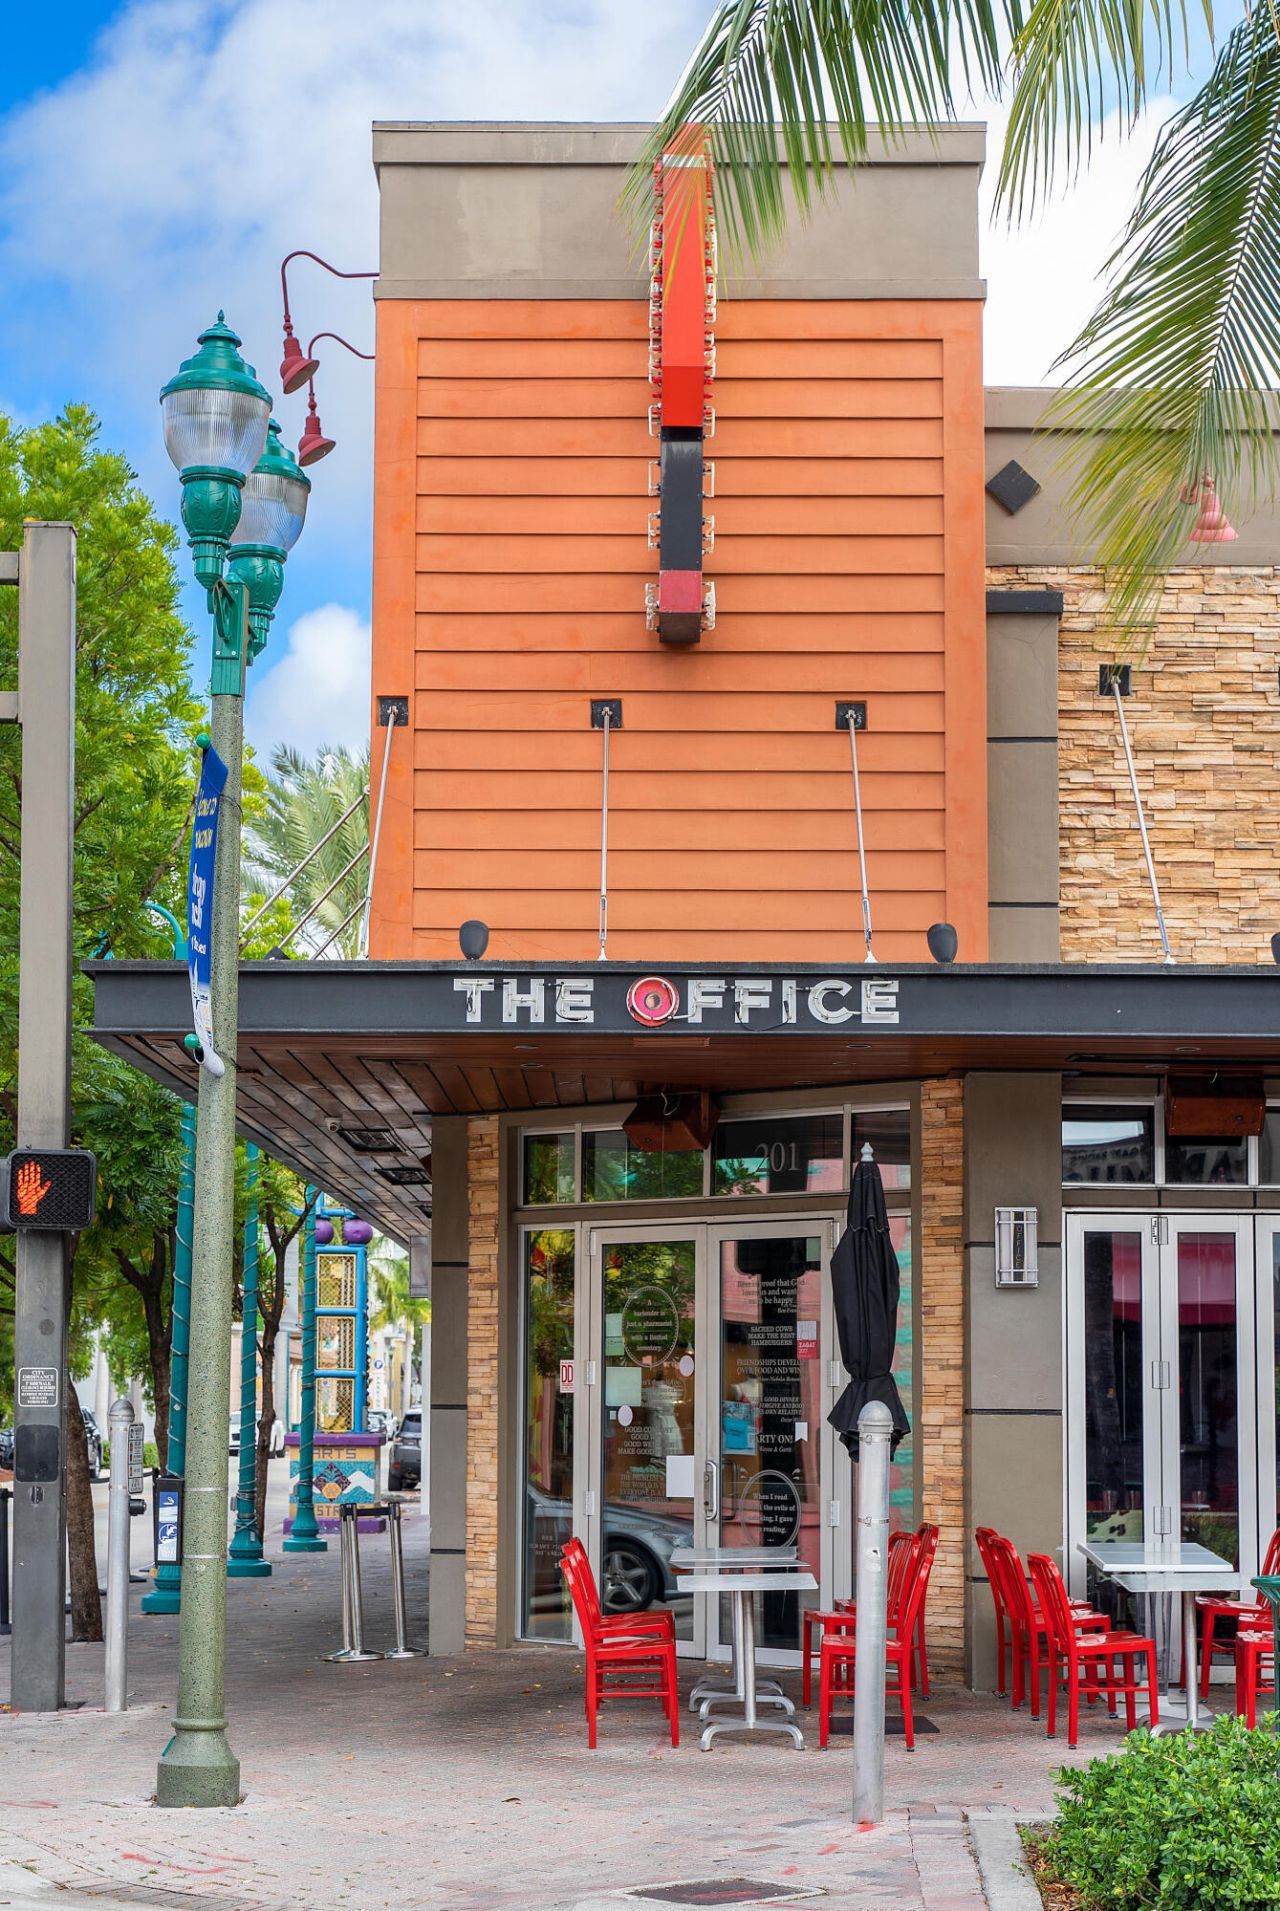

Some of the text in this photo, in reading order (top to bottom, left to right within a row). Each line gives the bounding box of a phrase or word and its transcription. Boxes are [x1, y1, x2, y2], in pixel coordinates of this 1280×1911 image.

[453, 975, 900, 1026] THE OFFICE
[755, 1142, 801, 1172] 201
[777, 1278, 790, 1286] that
[767, 1287, 780, 1296] and
[764, 1296, 773, 1304] be
[736, 1358, 777, 1366] FRIENDSHIPS
[754, 1366, 773, 1374] FOOD
[773, 1366, 788, 1374] AND
[788, 1366, 802, 1374] WIN
[777, 1434, 794, 1444] ON!
[752, 1492, 769, 1500] When
[763, 1526, 787, 1534] reading.
